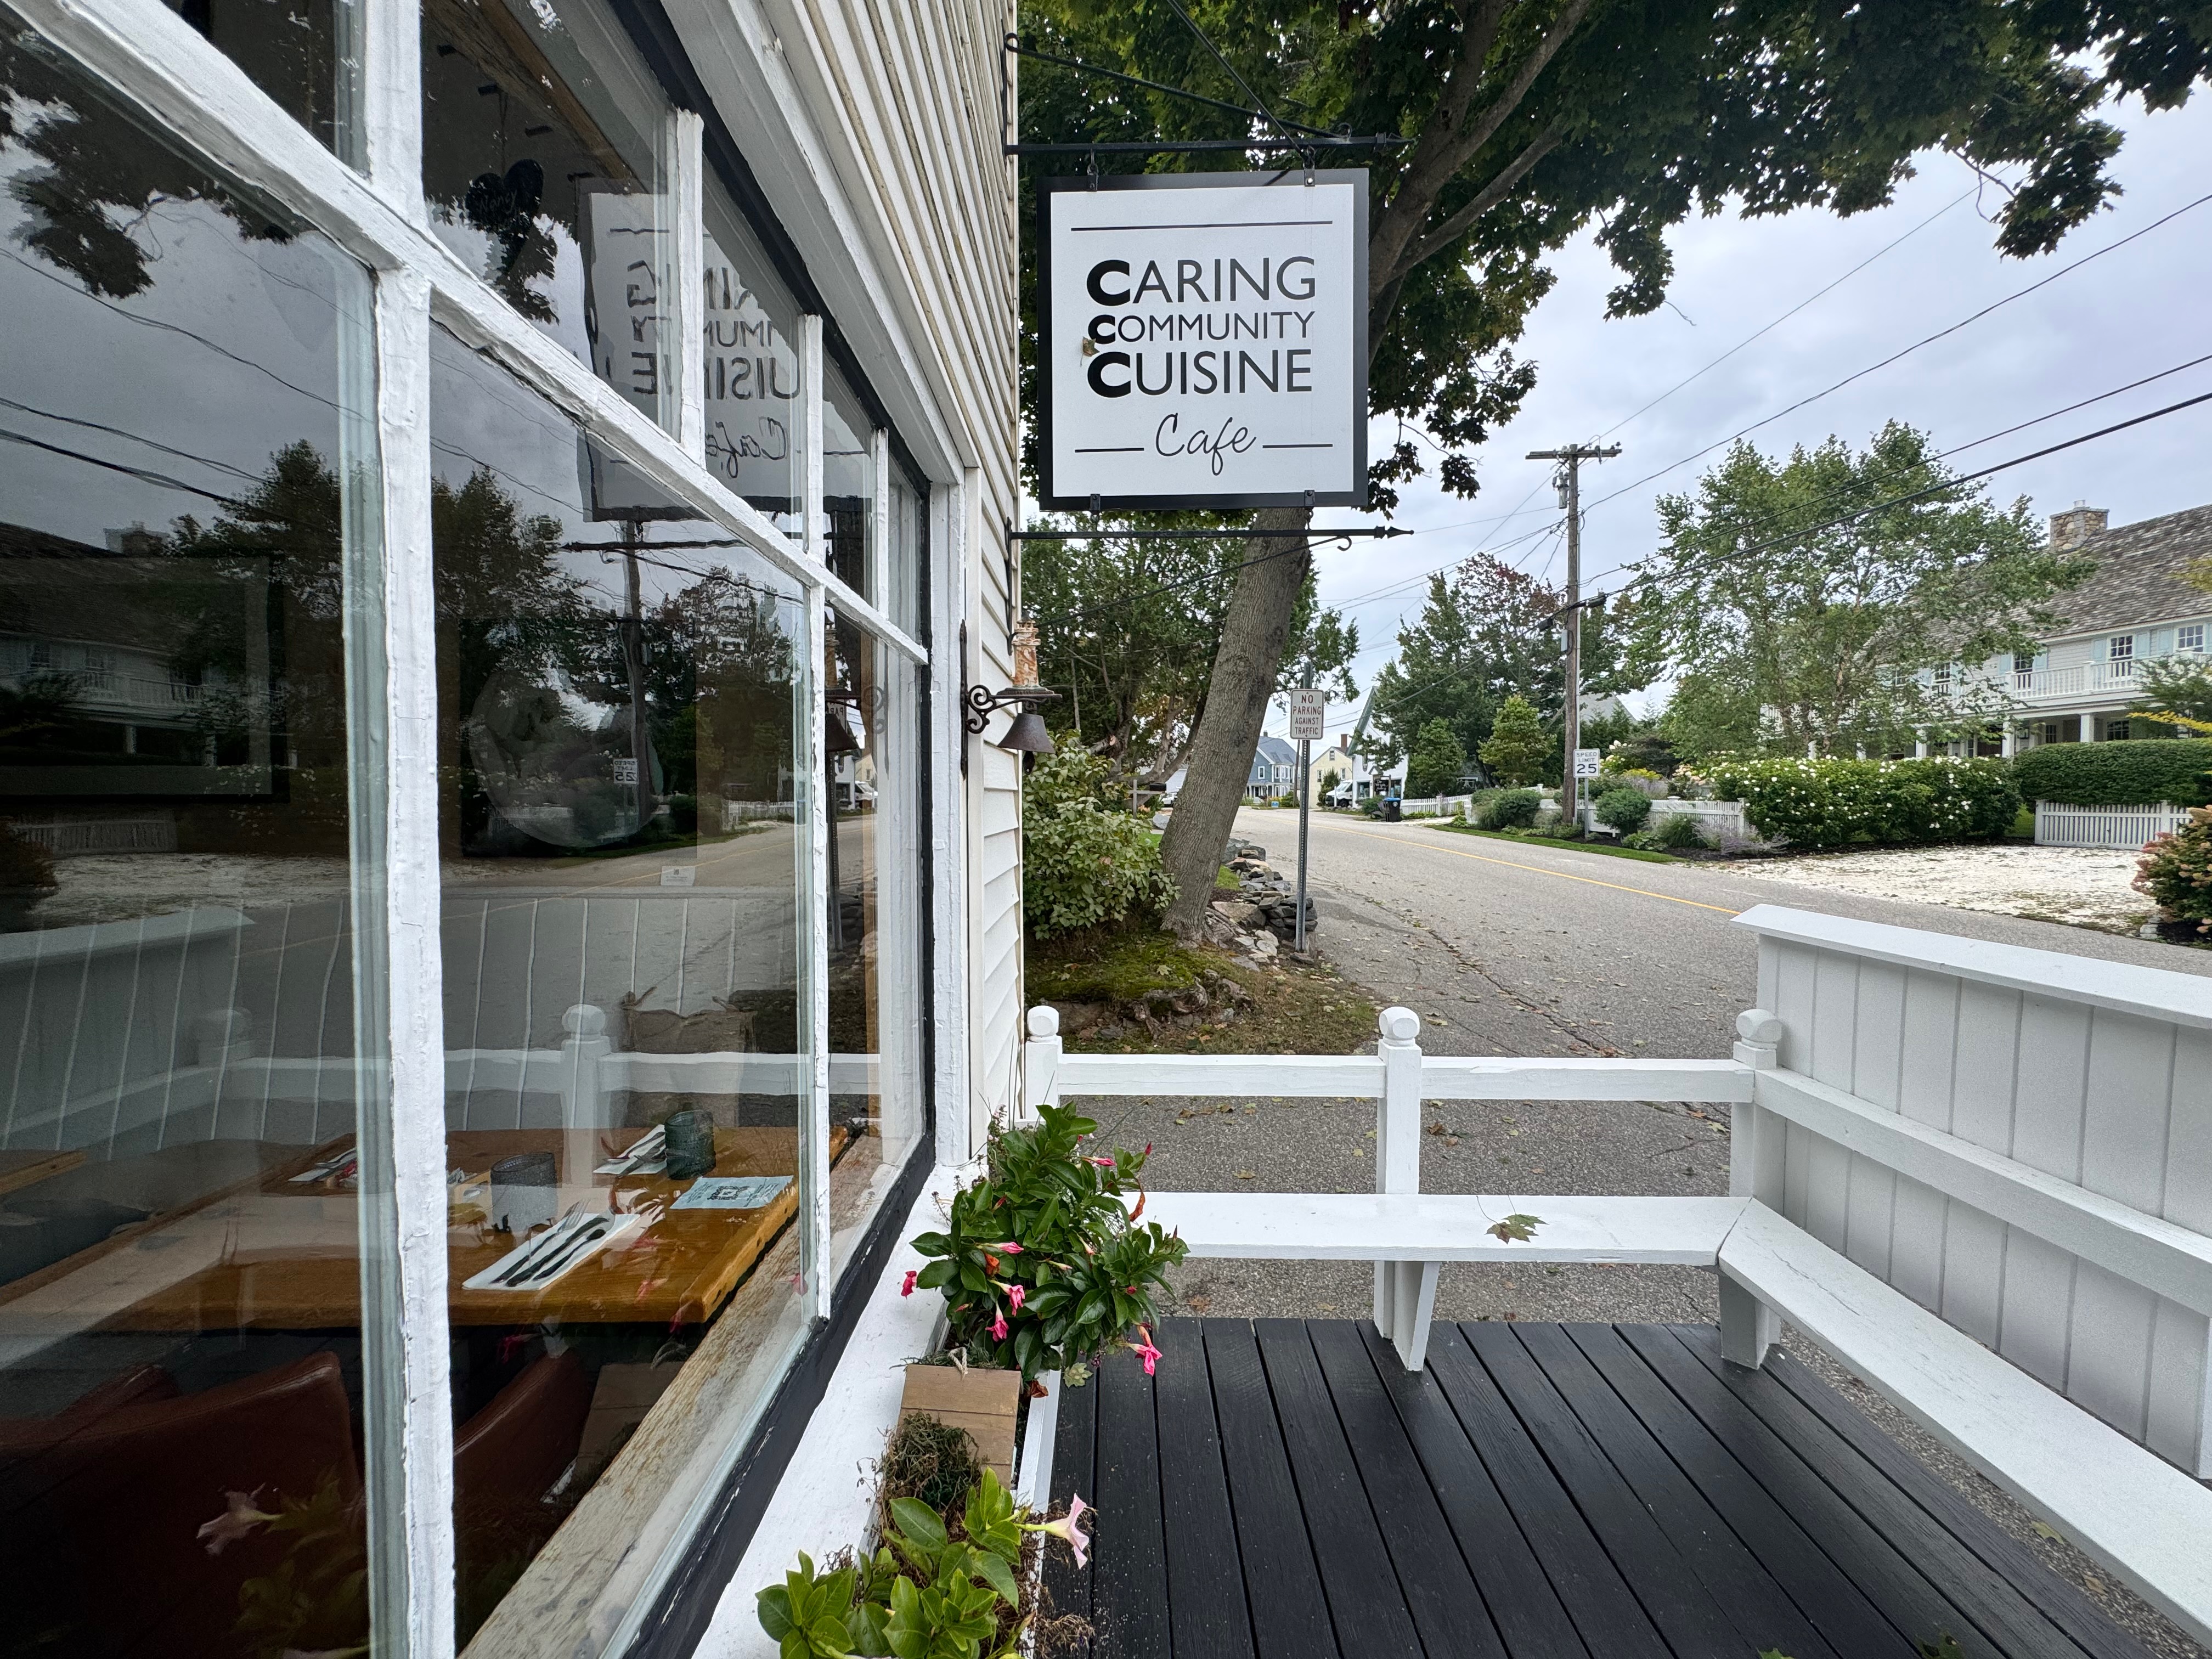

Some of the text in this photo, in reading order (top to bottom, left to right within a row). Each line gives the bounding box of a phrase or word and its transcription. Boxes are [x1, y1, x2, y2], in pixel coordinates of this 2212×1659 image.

[1086, 256, 1315, 307] CARING
[1088, 311, 1315, 345] COMMUNITY
[1087, 349, 1312, 398] CUISINE
[1155, 412, 1257, 476] Cafe
[1293, 706, 1321, 715] PARKING
[1301, 695, 1313, 703] NO
[1577, 764, 1596, 774] 25
